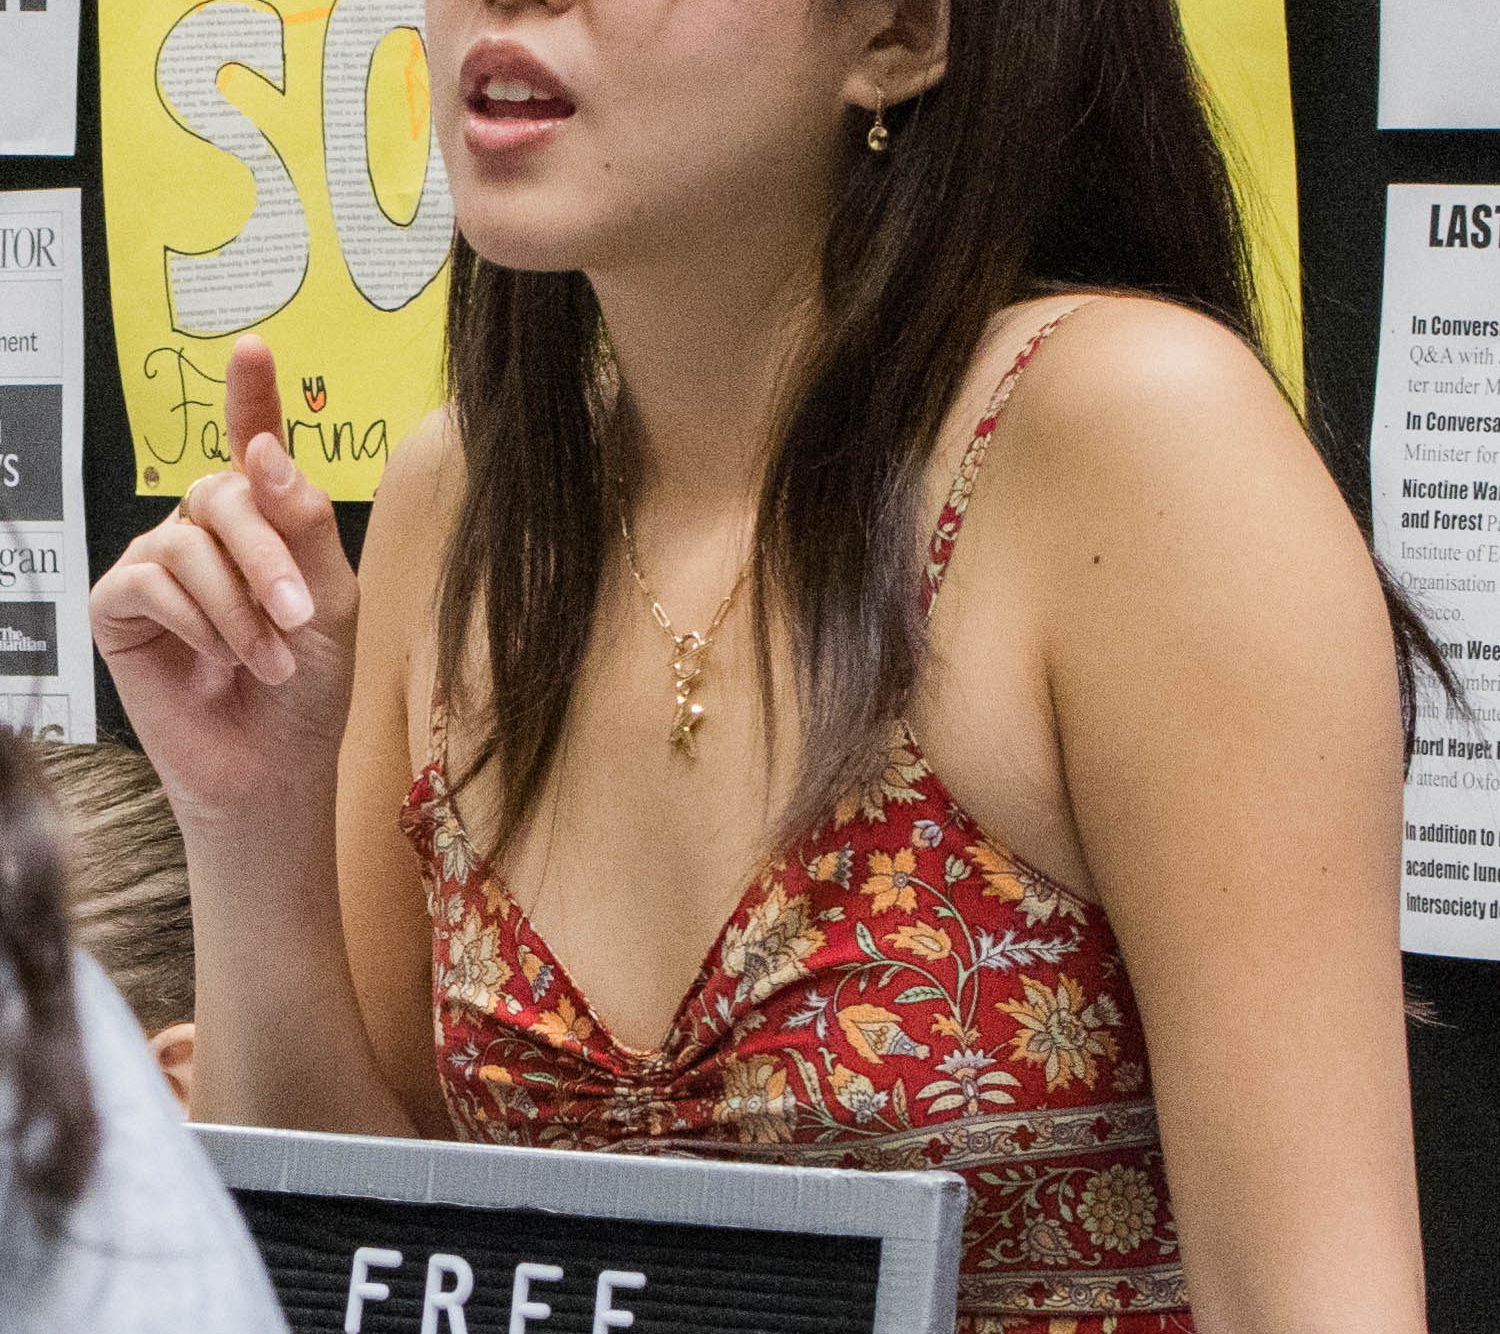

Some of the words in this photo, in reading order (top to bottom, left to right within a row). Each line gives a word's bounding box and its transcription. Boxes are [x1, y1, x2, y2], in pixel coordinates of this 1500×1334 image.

[1411, 314, 1427, 335] In
[1408, 344, 1454, 367] Q&A
[1457, 346, 1494, 365] with
[1407, 378, 1431, 393] ter
[1433, 376, 1481, 395] under
[1405, 410, 1422, 430] In
[1403, 442, 1472, 462] Minister
[1475, 444, 1499, 463] for
[1401, 478, 1469, 499] Nicotine
[1400, 509, 1430, 529] and
[1432, 509, 1483, 531] Forest
[1400, 541, 1462, 561] Institute
[1465, 543, 1486, 562] of
[1400, 571, 1496, 595] Organisation
[0, 627, 23, 640] The
[1411, 735, 1444, 757] ford
[1415, 770, 1458, 788] attend
[1405, 820, 1416, 841] In
[1418, 823, 1477, 845] addition
[1479, 827, 1495, 847] to
[1405, 858, 1470, 880] academic
[1405, 892, 1487, 920] intersociety
